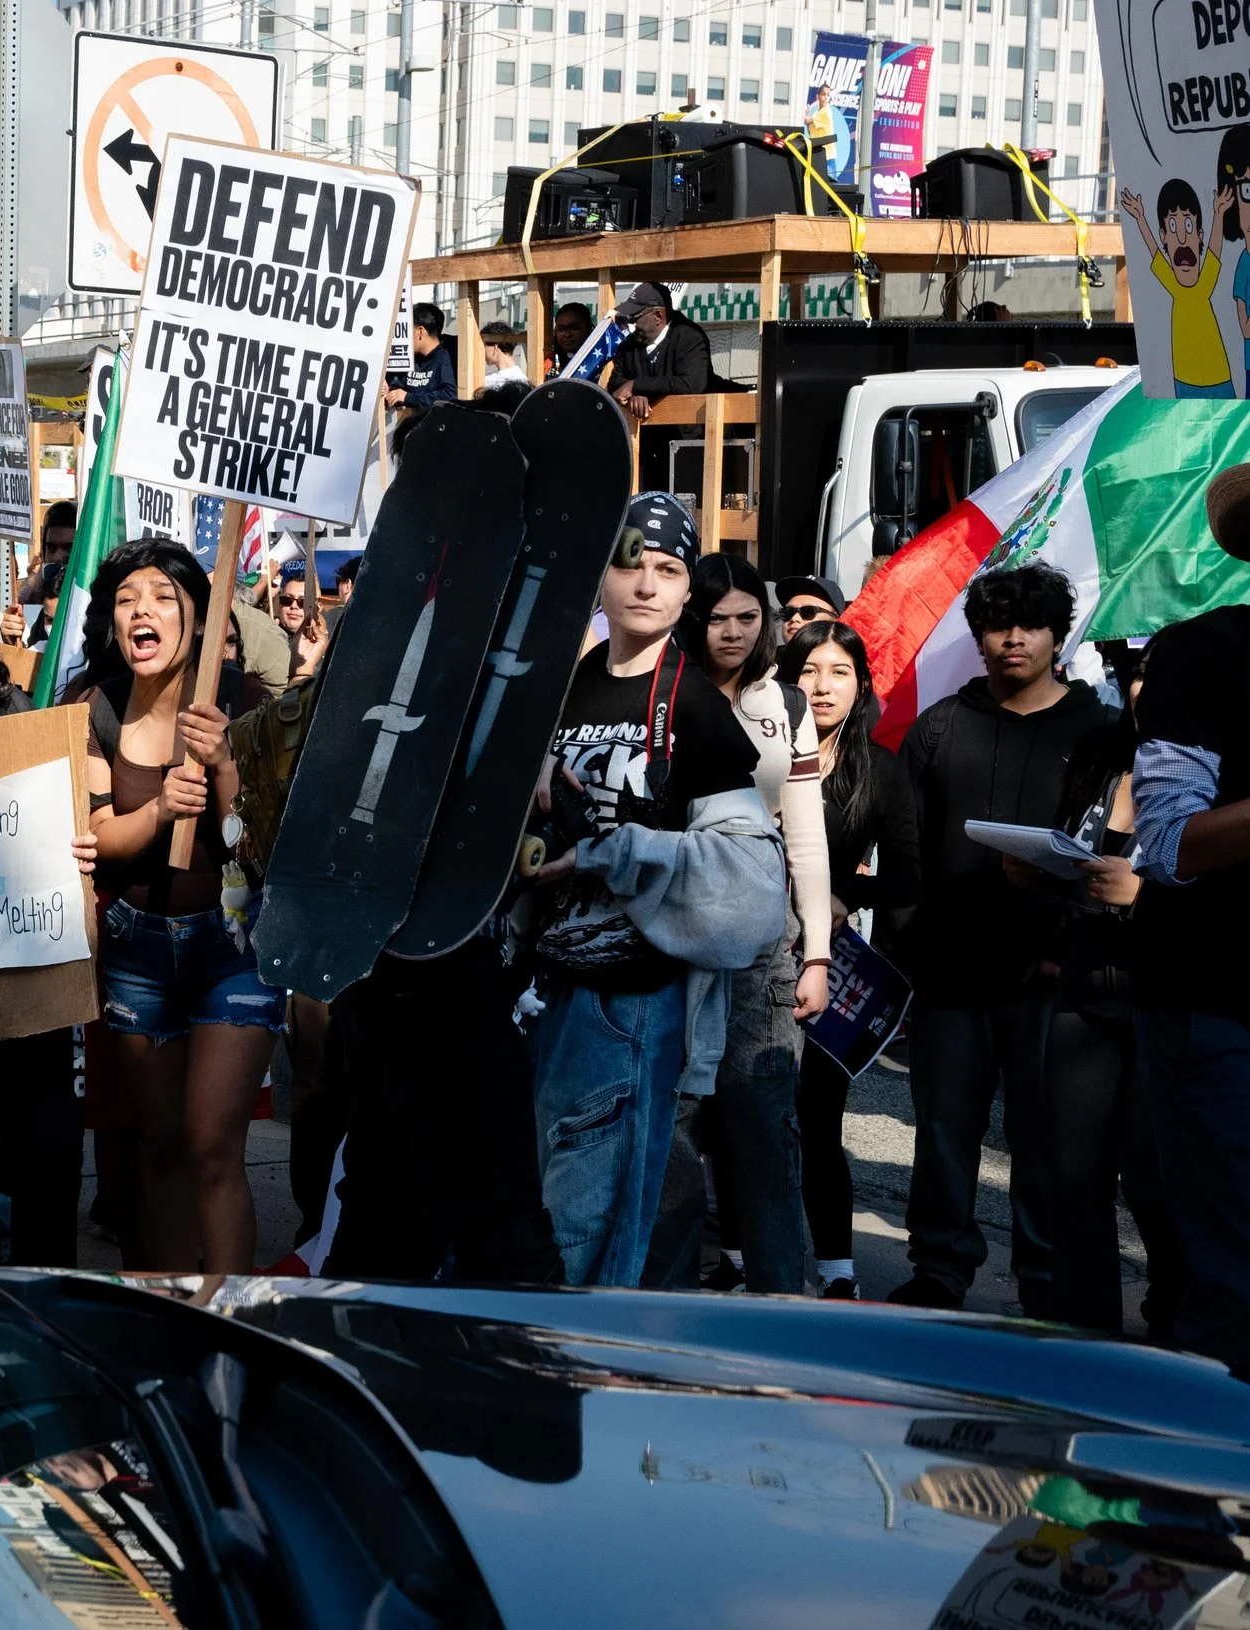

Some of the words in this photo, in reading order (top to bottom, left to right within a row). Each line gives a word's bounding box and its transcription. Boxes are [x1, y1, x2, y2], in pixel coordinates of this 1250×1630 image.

[809, 53, 867, 92] GAME
[876, 62, 912, 98] ON!
[874, 98, 899, 114] SPORTS
[905, 101, 922, 116] PLAY
[1168, 72, 1250, 126] REPUB
[879, 118, 920, 130] EXHIBITION
[168, 157, 396, 280] DEFEND
[156, 245, 379, 338] DEMOCRACY:
[216, 332, 296, 398] TIME
[296, 349, 370, 412] FOR
[11, 403, 26, 438] FOR
[157, 376, 180, 427] A
[186, 381, 332, 458] GENERAL
[172, 429, 306, 504] STRIKE!
[10, 475, 30, 507] GOOD
[576, 721, 676, 752] REMINDR
[654, 702, 668, 748] Canon
